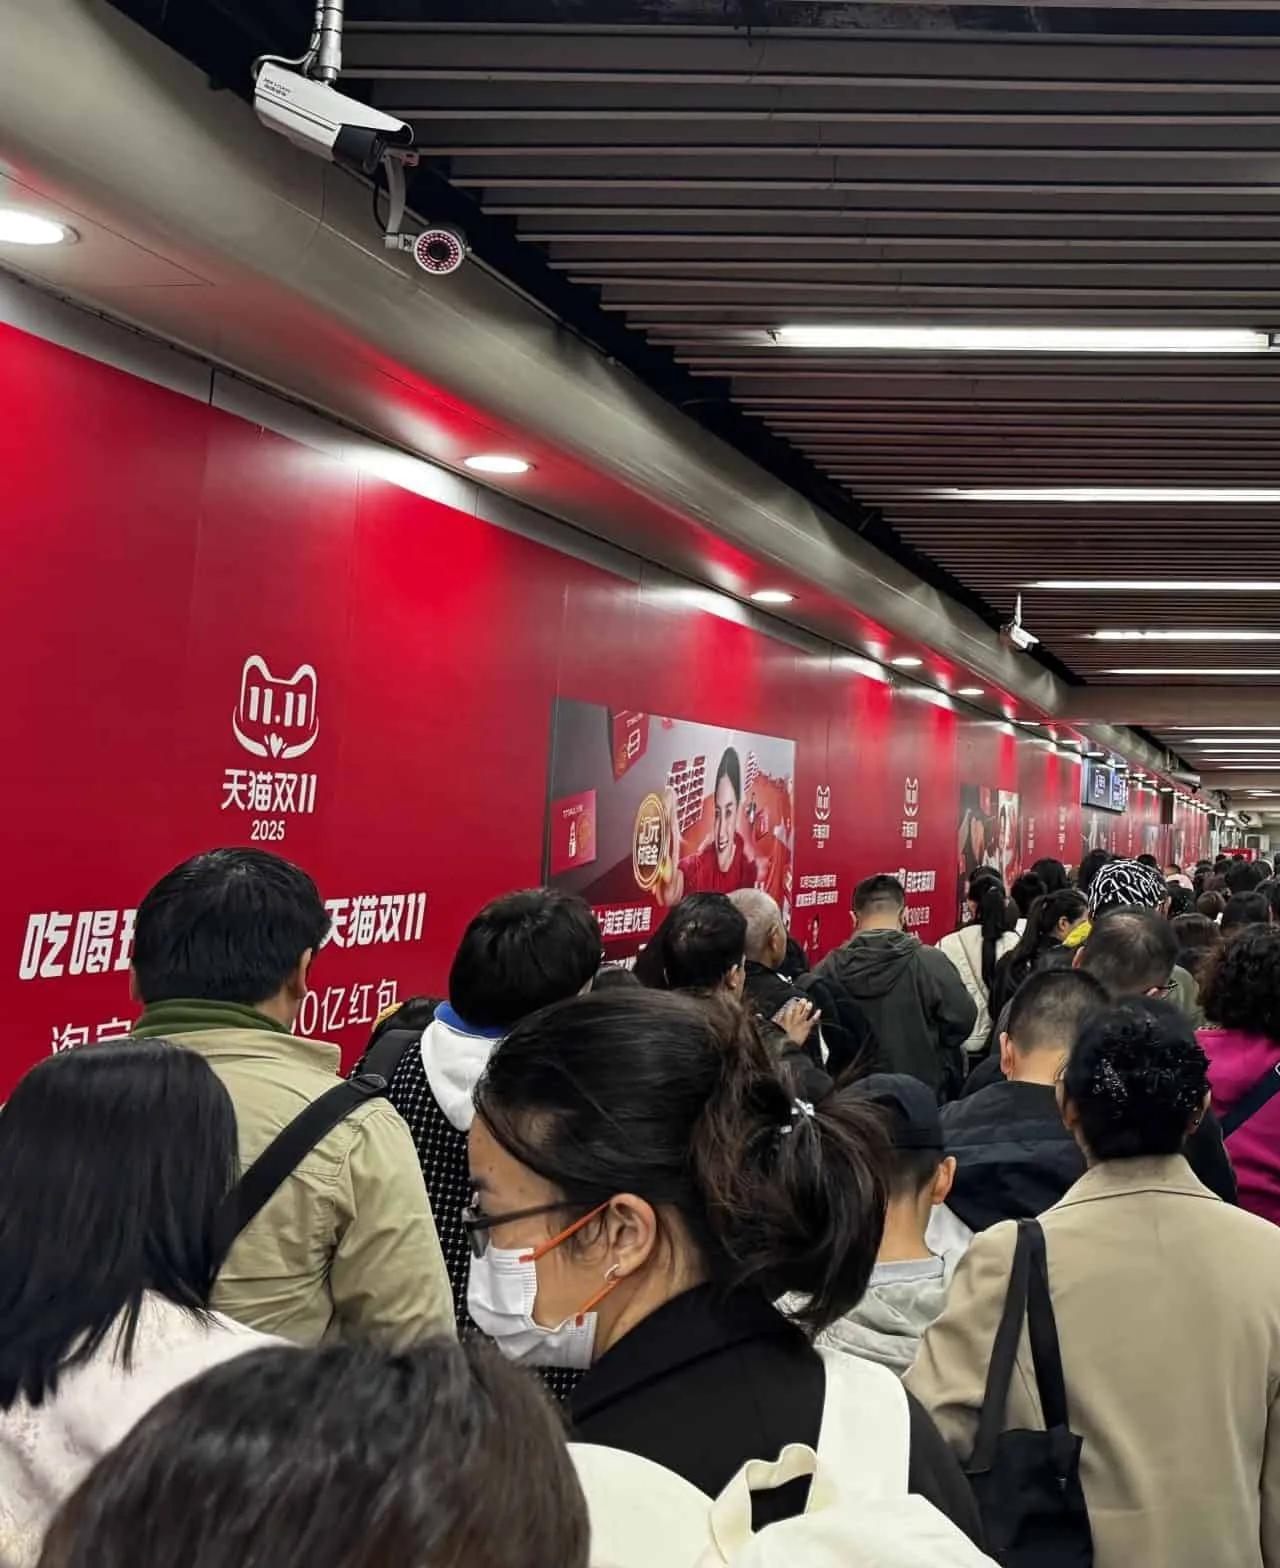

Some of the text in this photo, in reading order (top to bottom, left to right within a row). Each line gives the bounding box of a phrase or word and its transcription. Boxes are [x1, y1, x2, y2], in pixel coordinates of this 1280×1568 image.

[249, 686, 307, 727] 11.11
[221, 769, 317, 813] 天猫双11
[250, 820, 285, 840] 2025
[319, 892, 427, 950] 天猫双11
[291, 979, 398, 1037] 0亿红包
